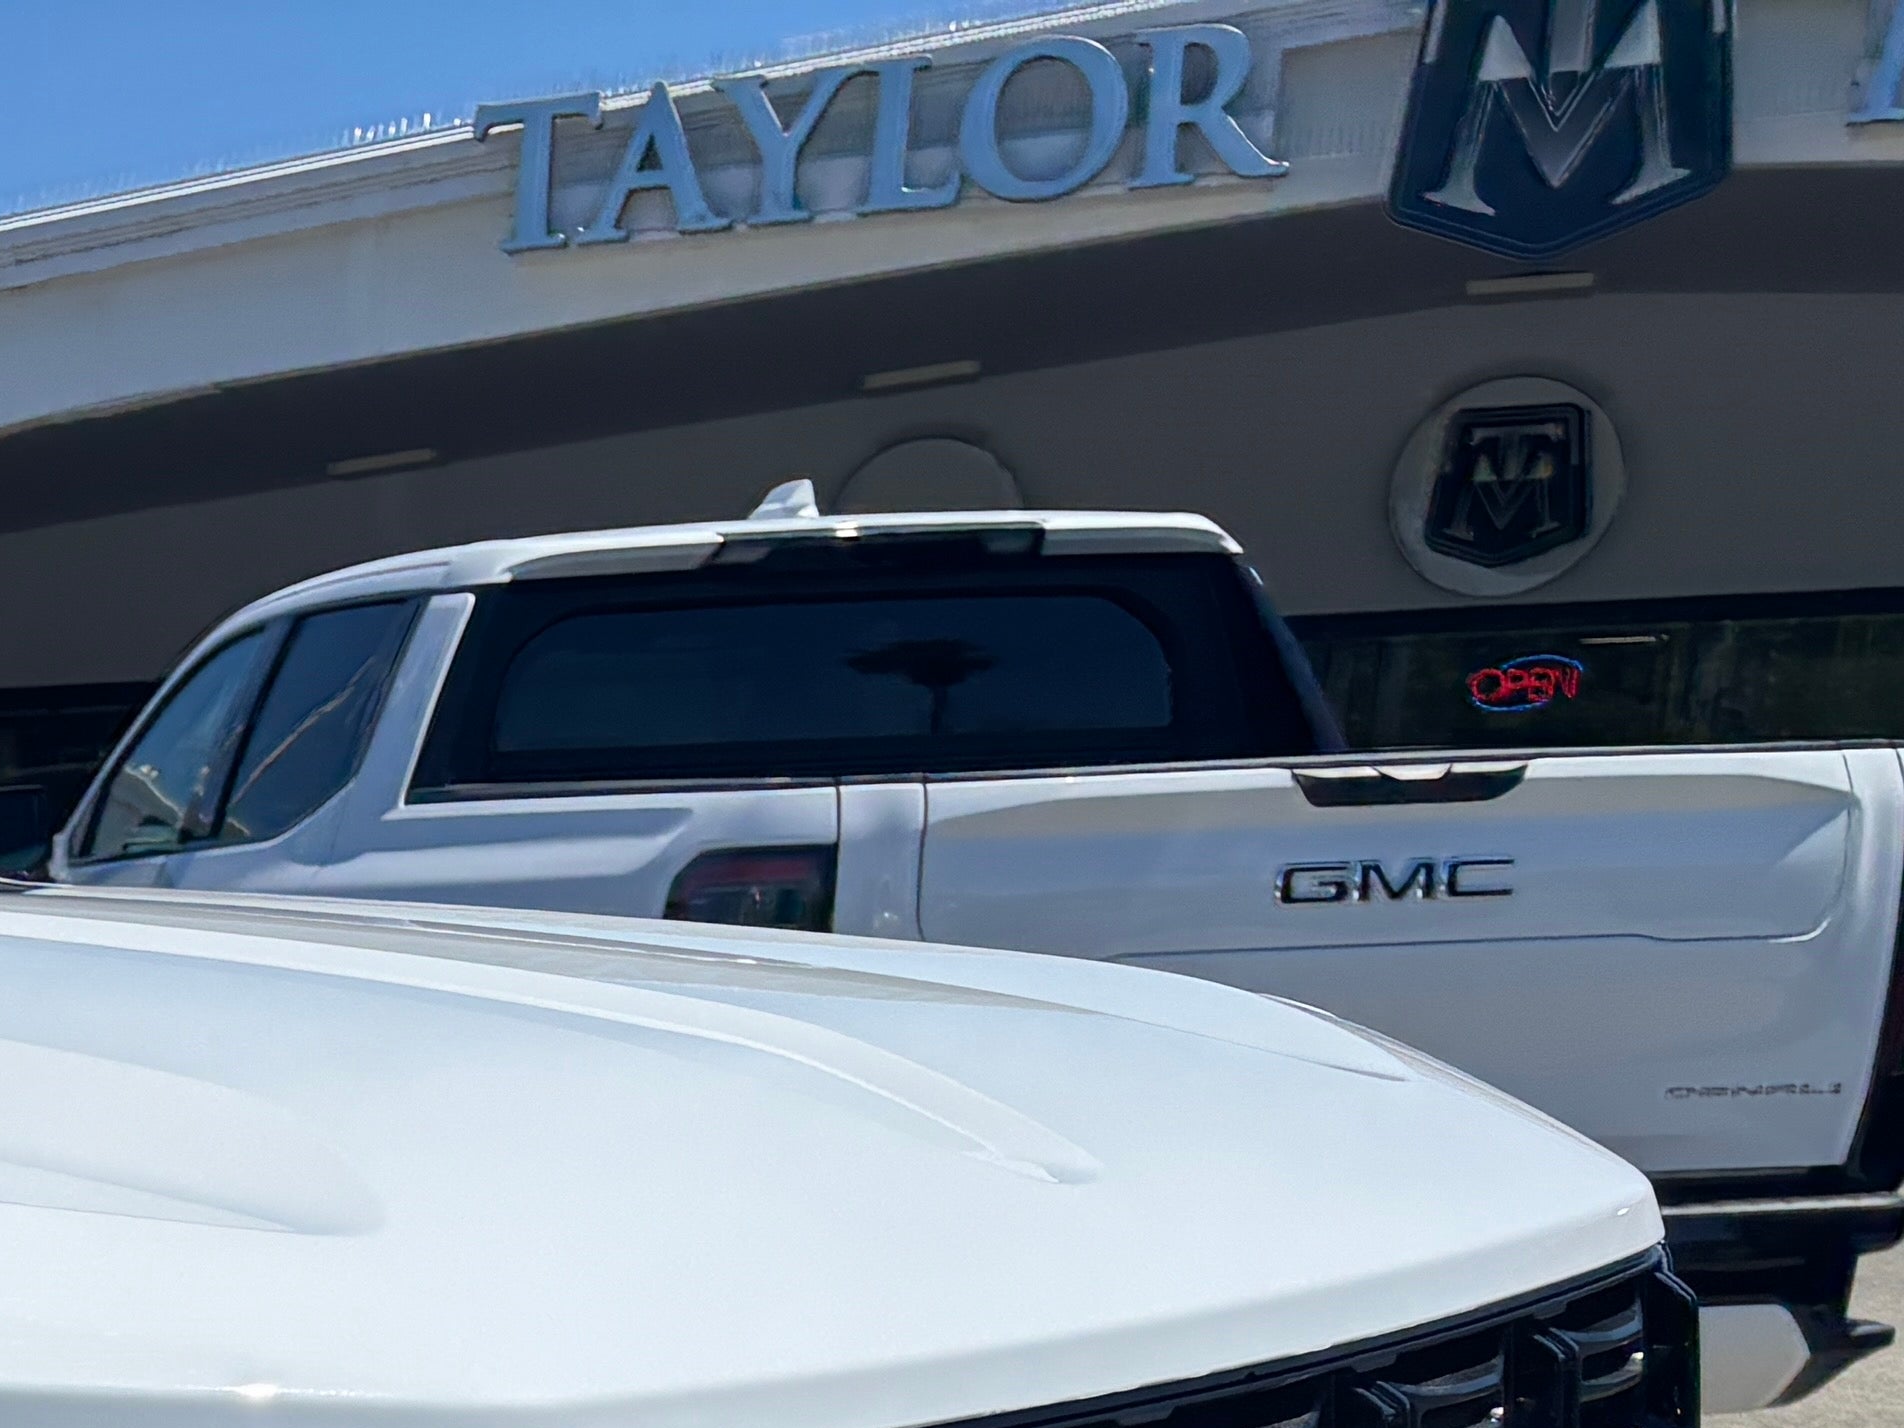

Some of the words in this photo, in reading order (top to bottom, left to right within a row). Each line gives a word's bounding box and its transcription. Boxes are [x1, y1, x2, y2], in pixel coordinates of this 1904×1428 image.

[475, 24, 1290, 254] TAYLOR
[1467, 662, 1582, 702] OPEN
[1274, 855, 1515, 905] GMC
[1664, 1082, 1842, 1100] DENALI
